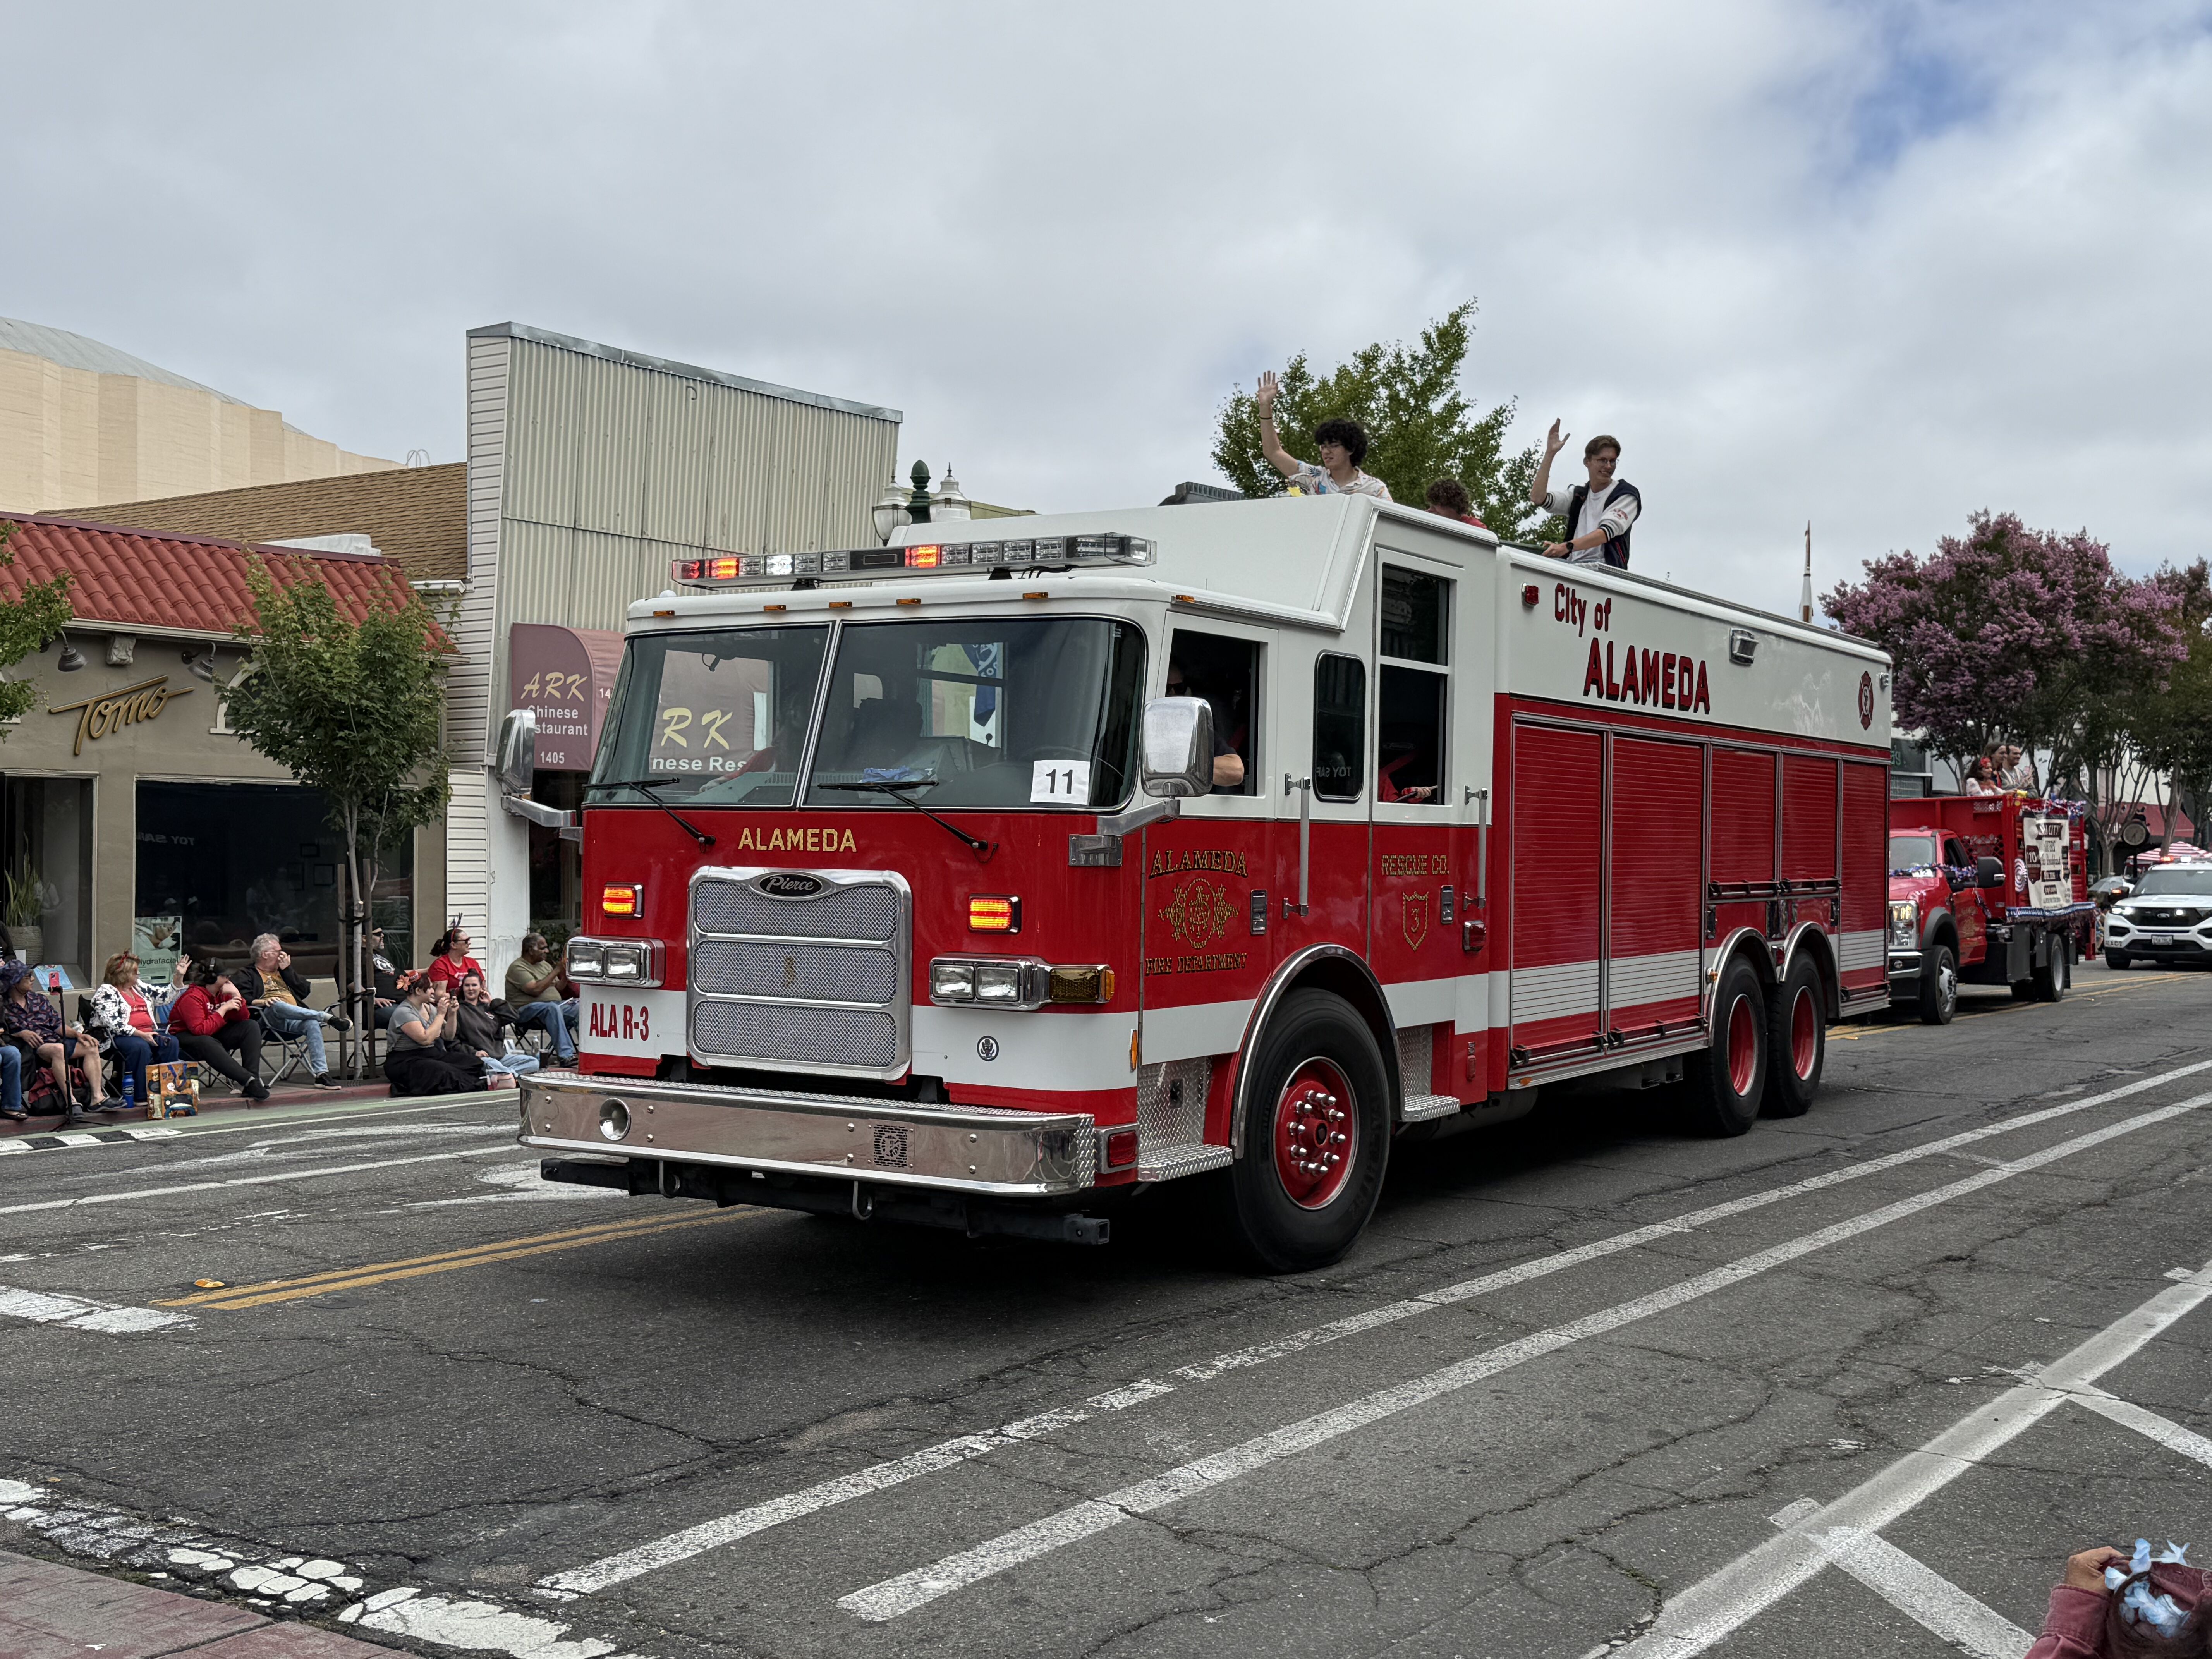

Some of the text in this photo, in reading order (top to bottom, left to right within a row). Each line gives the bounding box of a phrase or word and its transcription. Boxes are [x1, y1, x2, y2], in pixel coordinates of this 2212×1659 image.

[1555, 583, 1611, 637] City of
[520, 672, 588, 702] ARK
[1583, 637, 1710, 715] ALAMEDA
[49, 675, 194, 755] Tomo
[541, 751, 565, 764] 1405
[653, 758, 702, 771] nese
[1046, 769, 1073, 794] 11
[738, 828, 857, 852] ALAMEDA
[1148, 850, 1248, 879] ALAMEDA
[1381, 855, 1449, 875] RESCUE CO.
[766, 876, 814, 891] Pierce
[1411, 908, 1419, 932] 3
[1145, 953, 1247, 976] FIRE DEPARTMENT
[589, 1003, 649, 1041] ALA R-3
